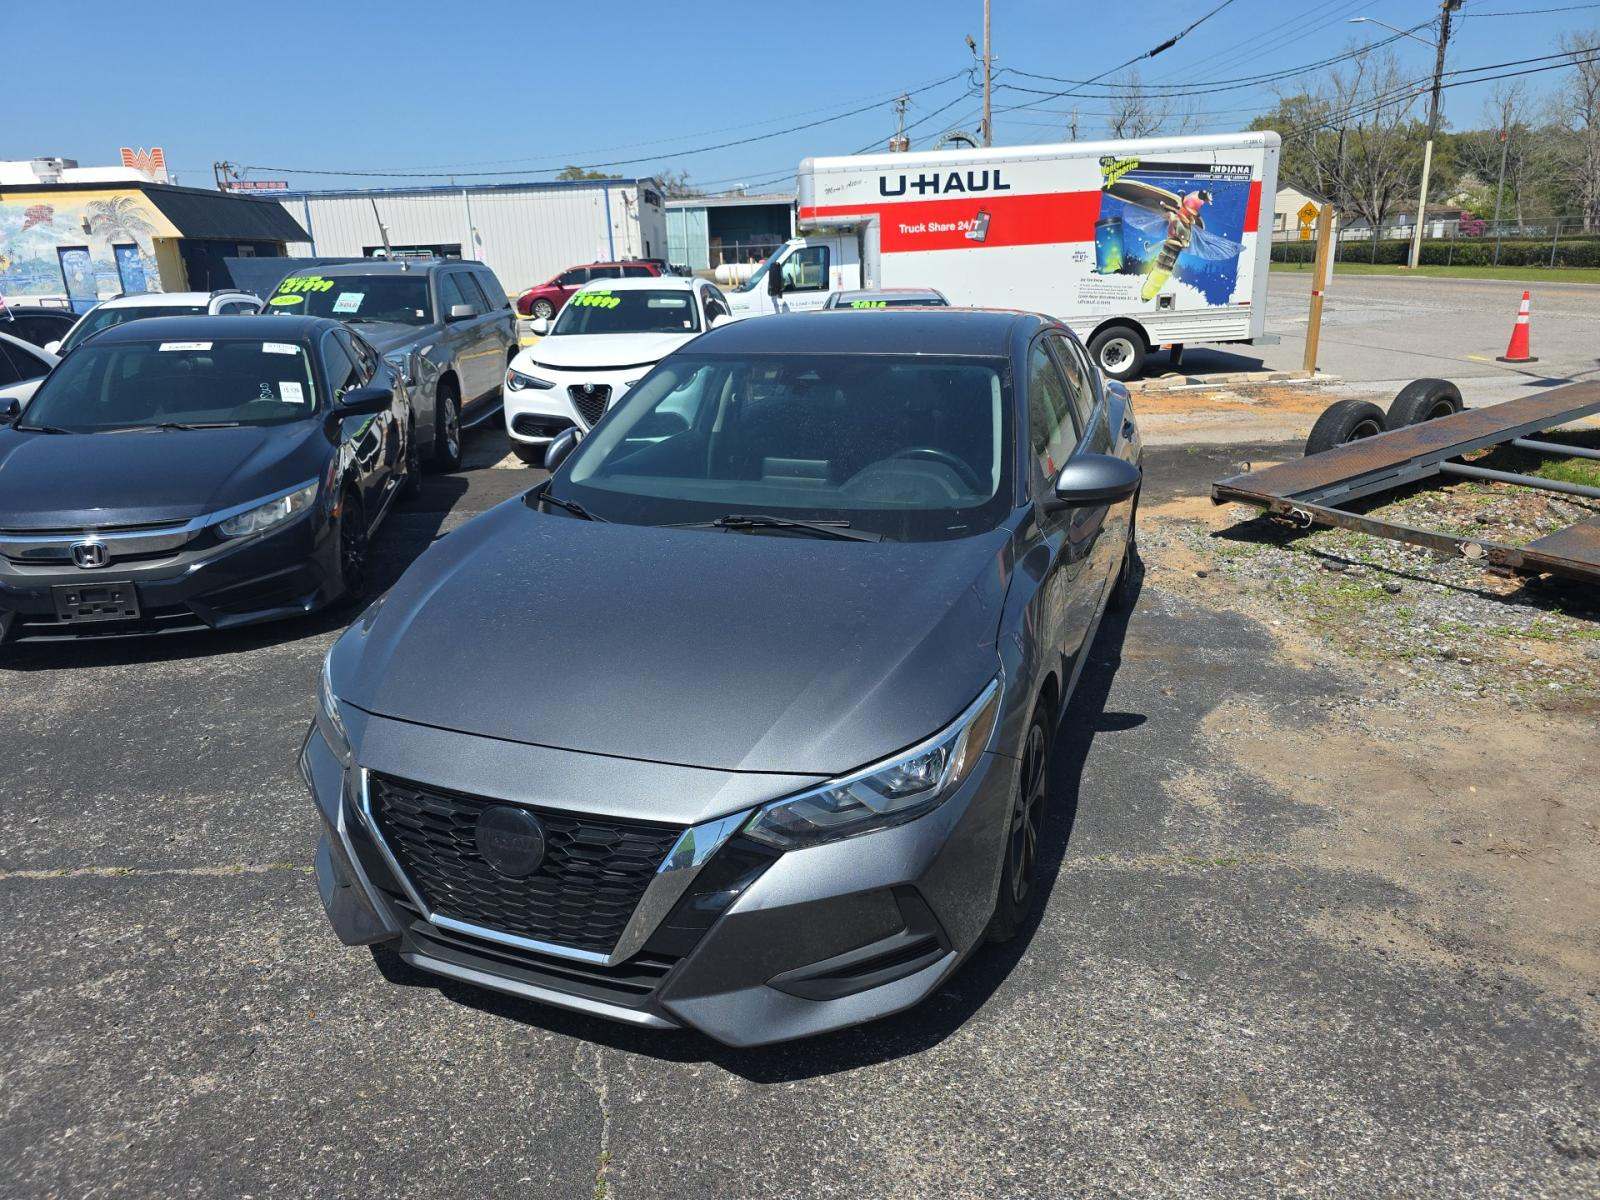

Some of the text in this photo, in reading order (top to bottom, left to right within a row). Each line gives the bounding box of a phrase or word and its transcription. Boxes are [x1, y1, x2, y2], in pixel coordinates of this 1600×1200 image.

[1210, 165, 1250, 174] INDIANA
[879, 169, 1011, 197] U-HAUL
[899, 223, 926, 234] Truck
[928, 221, 956, 232] Share
